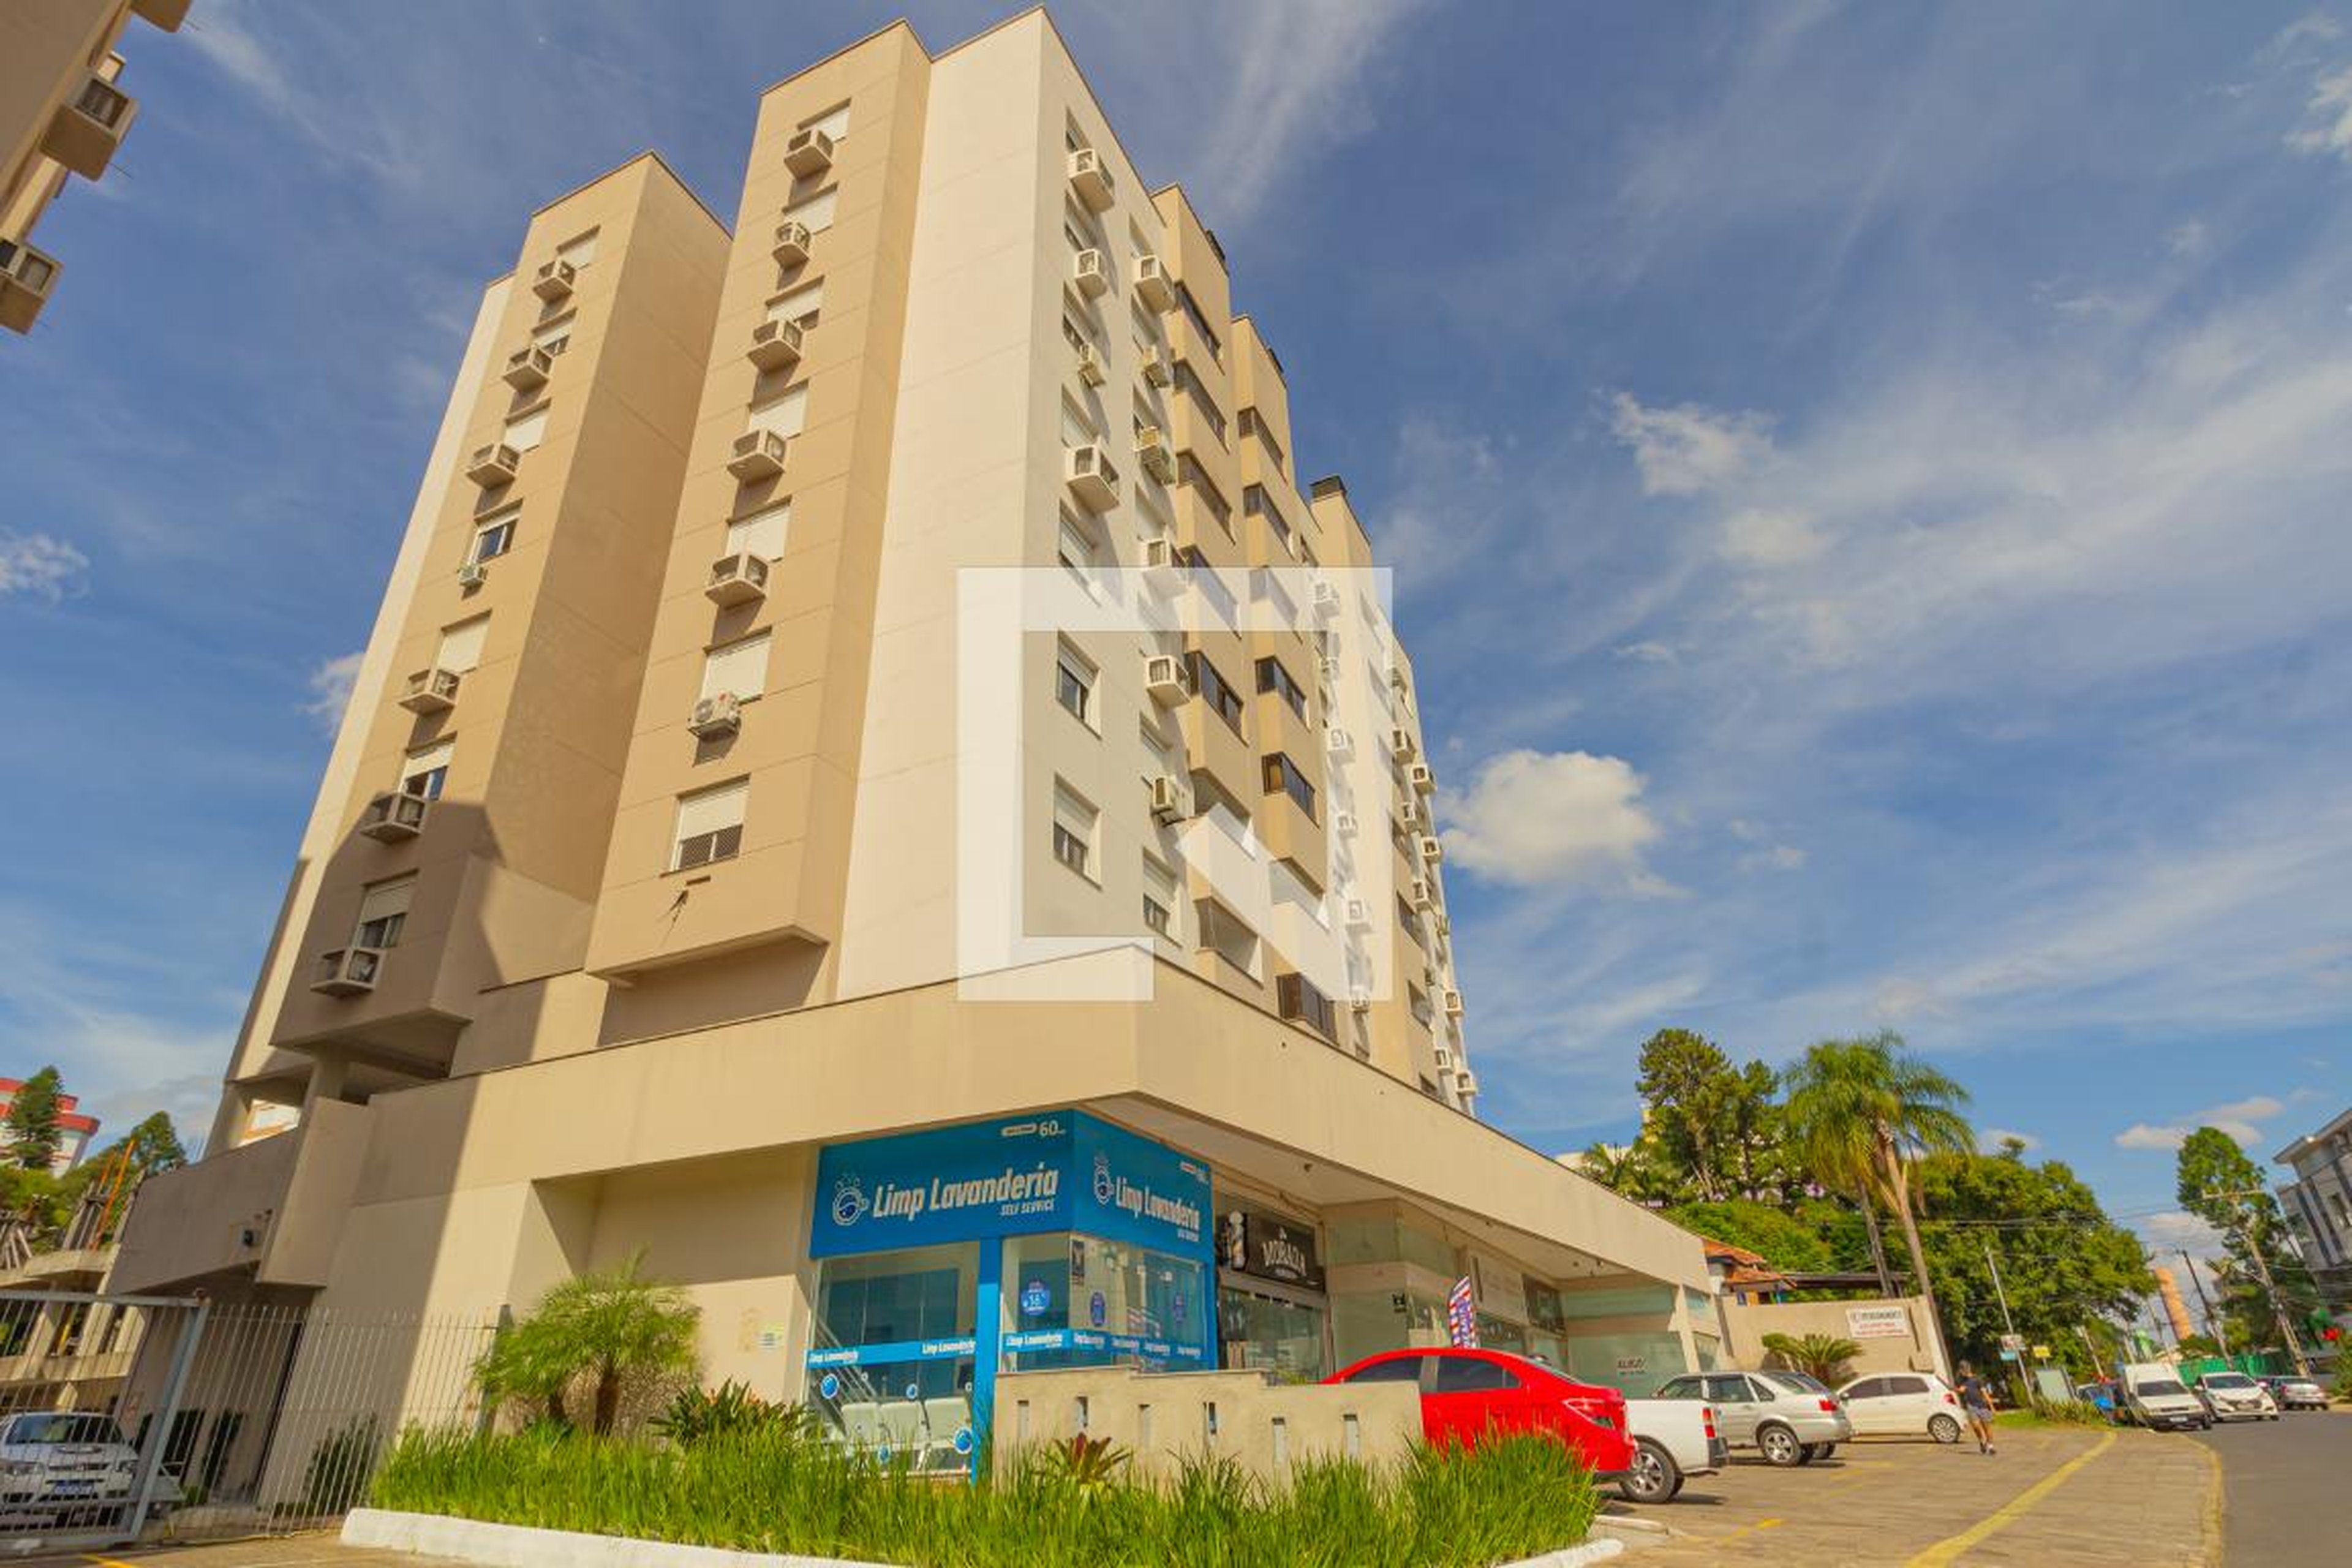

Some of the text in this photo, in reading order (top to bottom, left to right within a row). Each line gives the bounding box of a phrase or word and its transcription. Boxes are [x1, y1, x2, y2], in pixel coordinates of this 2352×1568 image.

[873, 1161, 1059, 1221] Limp Lavanderia
[1116, 1176, 1143, 1218] Limp
